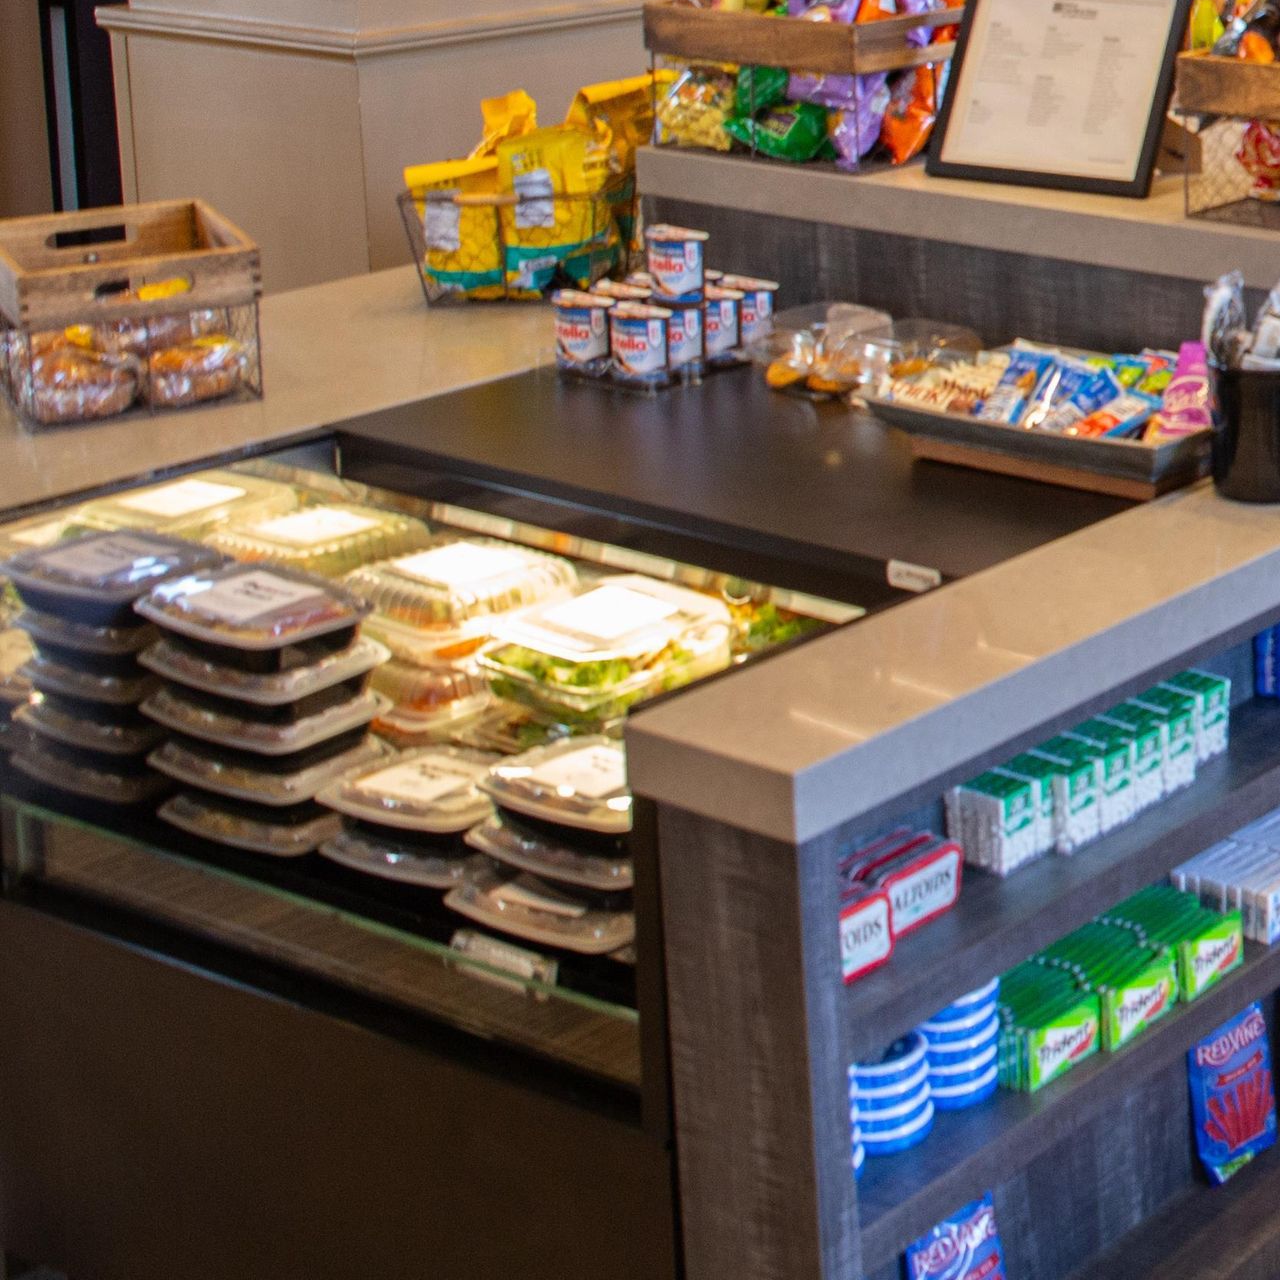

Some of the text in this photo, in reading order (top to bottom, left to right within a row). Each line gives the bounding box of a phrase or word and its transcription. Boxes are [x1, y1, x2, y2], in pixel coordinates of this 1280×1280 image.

[649, 257, 684, 273] tella
[895, 870, 950, 911] ALTOIDS
[844, 918, 882, 951] OIDS
[1194, 935, 1235, 974] Trident
[1119, 982, 1163, 1022] Trident
[1040, 1022, 1089, 1063] Trident
